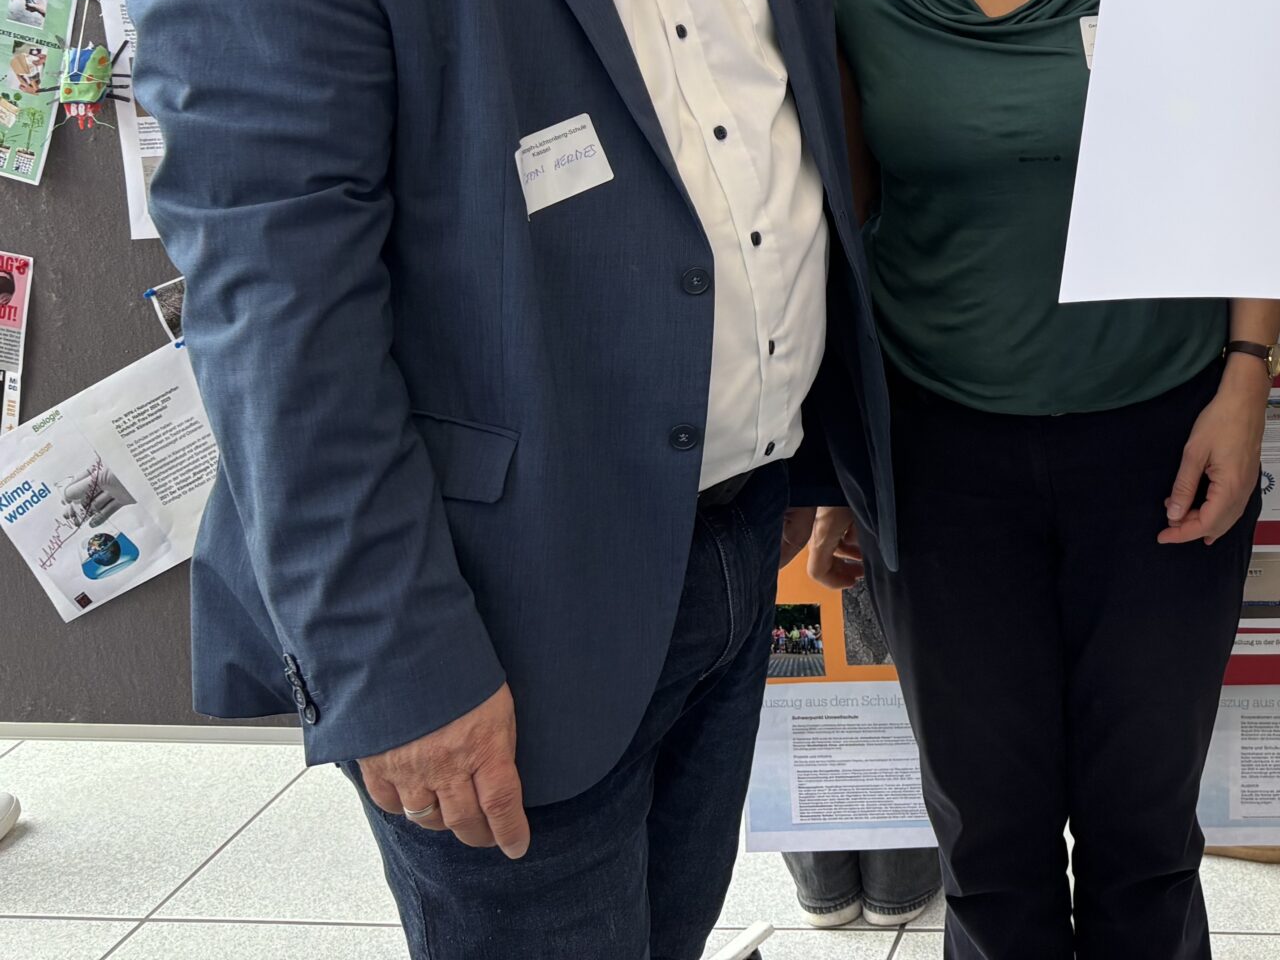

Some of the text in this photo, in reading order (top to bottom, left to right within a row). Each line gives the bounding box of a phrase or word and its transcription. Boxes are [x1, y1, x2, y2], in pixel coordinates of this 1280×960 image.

[31, 409, 61, 433] Biologie
[4, 482, 52, 524] wandel
[805, 698, 829, 708] aus
[830, 695, 859, 707] dem
[861, 694, 905, 709] Schulp
[1219, 697, 1250, 710] szug
[1252, 697, 1275, 709] aus
